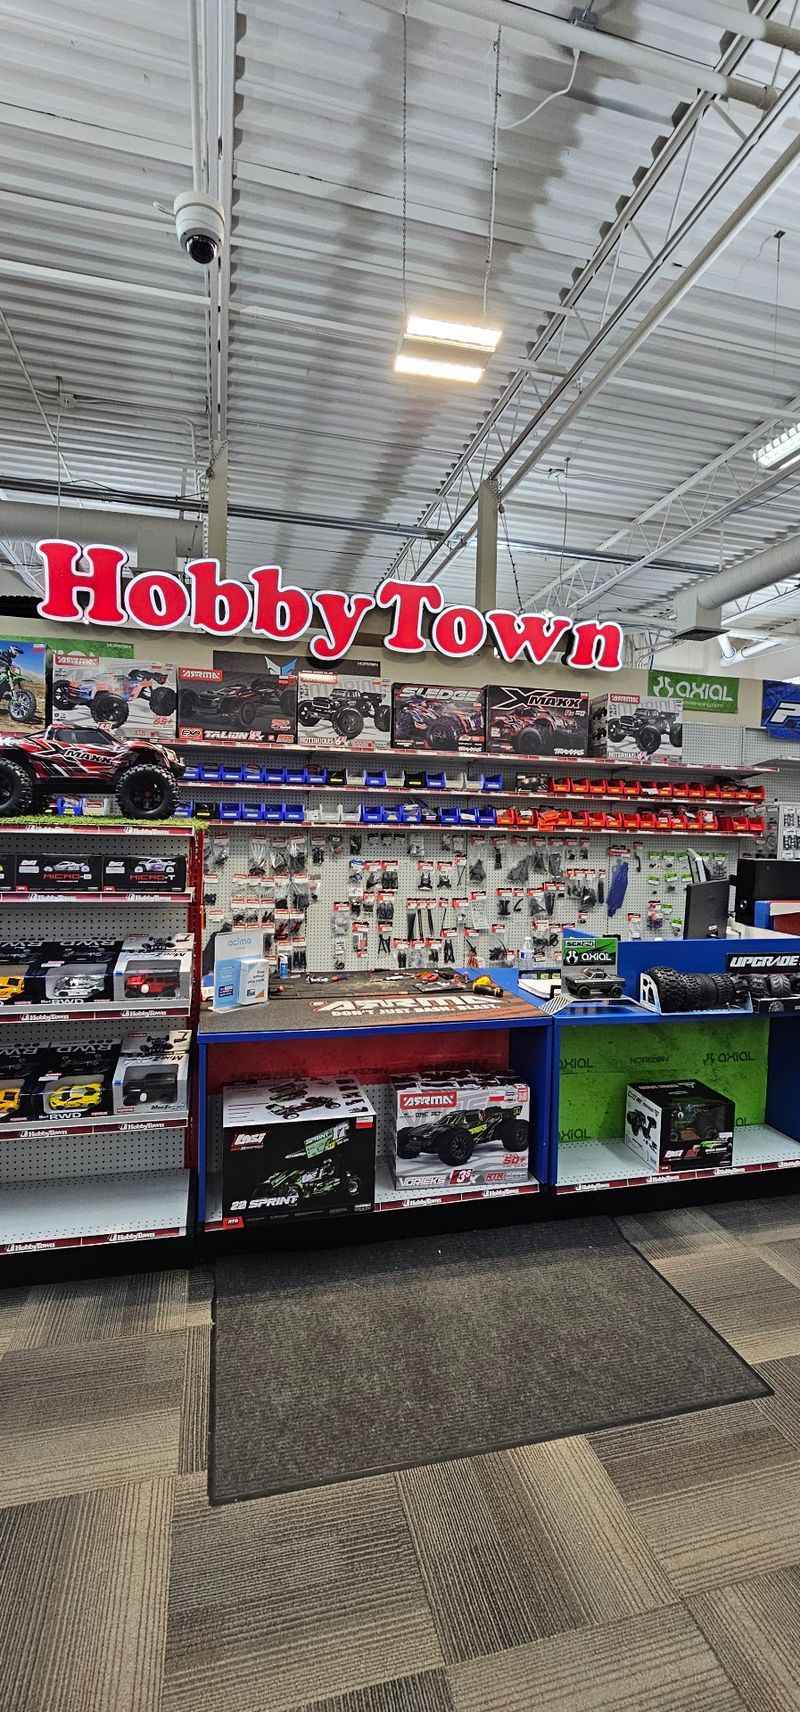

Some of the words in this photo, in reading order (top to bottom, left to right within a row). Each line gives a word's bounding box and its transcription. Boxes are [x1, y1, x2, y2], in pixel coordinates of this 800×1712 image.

[38, 539, 624, 671] HobbyTown
[400, 687, 480, 702] SLEDGE
[248, 1196, 299, 1209] SPRINT
